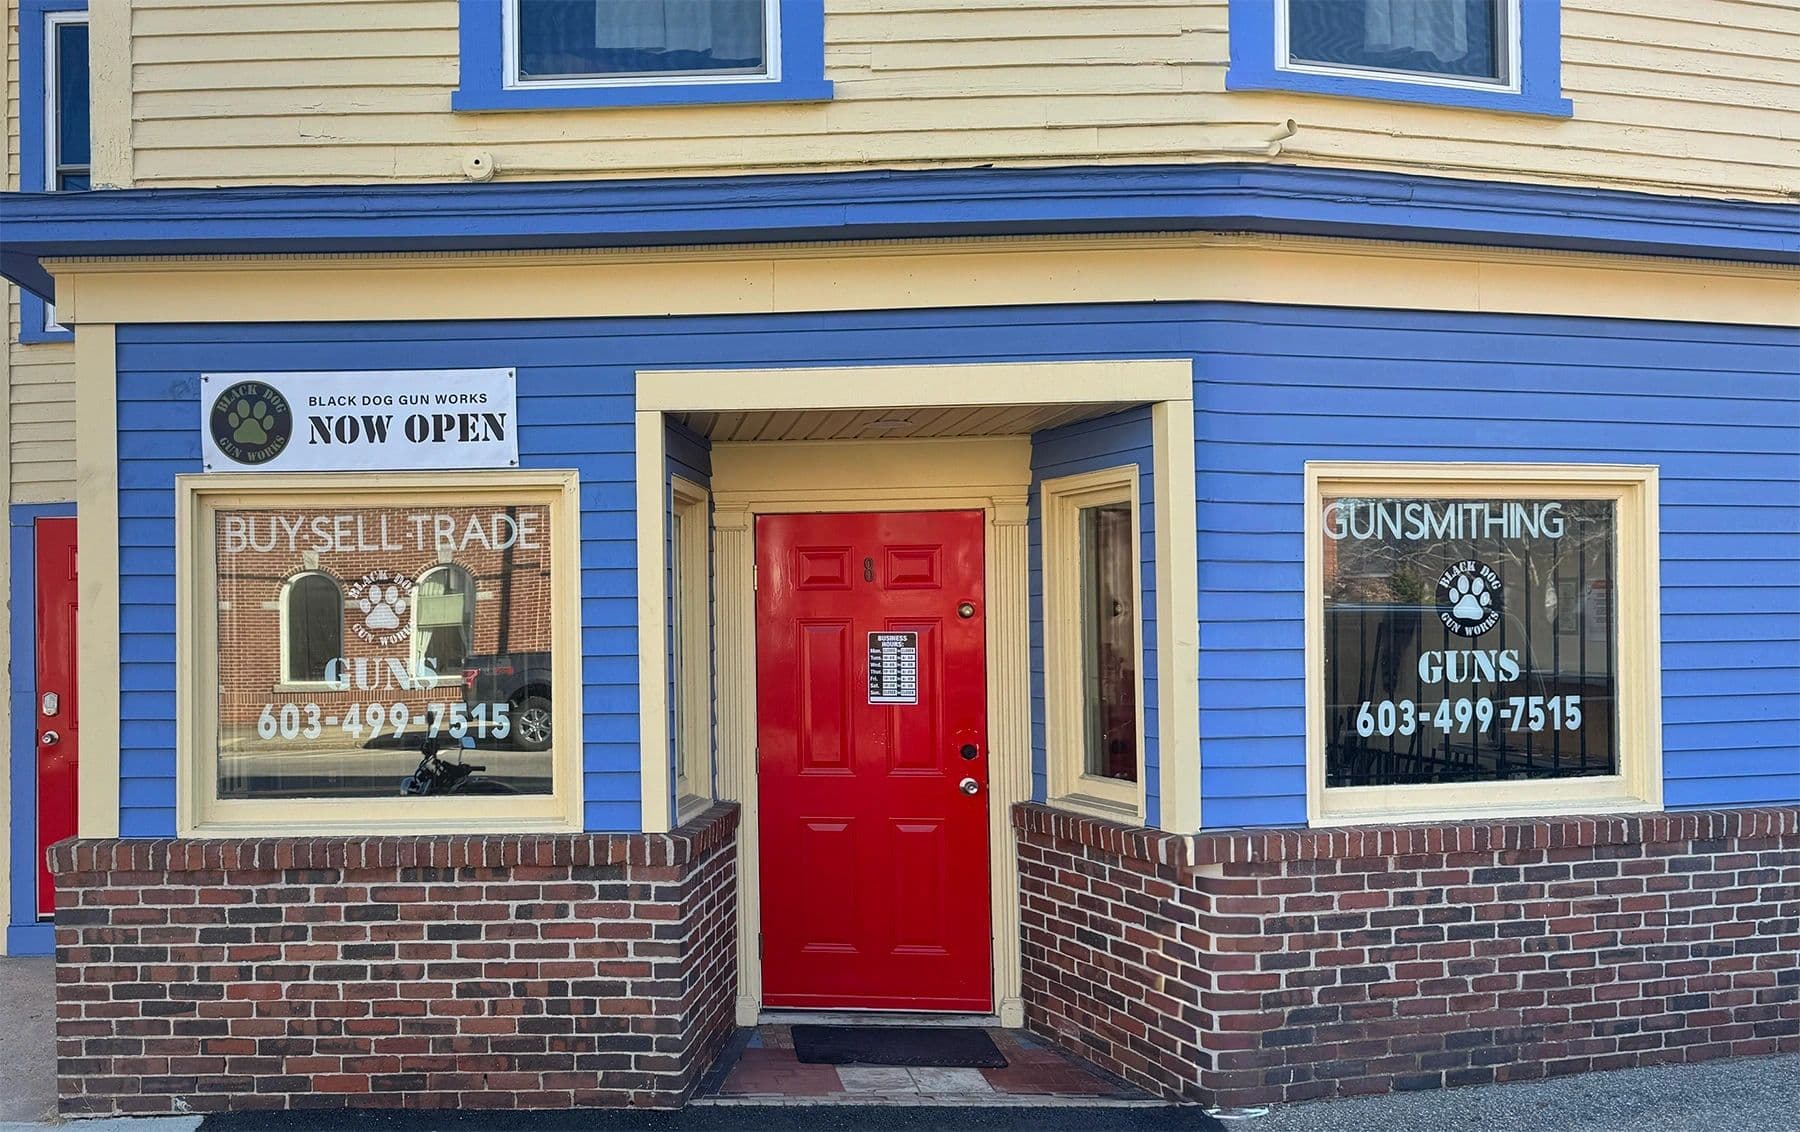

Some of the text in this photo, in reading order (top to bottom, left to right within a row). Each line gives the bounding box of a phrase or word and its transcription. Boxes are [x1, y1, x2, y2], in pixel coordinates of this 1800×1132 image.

[217, 384, 287, 413] BLACK DOG
[308, 393, 488, 407] BLACK DOG GUN WORKS
[308, 412, 507, 445] NOW OPEN
[219, 434, 286, 461] GUN WORKS
[1322, 502, 1565, 541] GUNSMITHING
[348, 570, 388, 599] BLACK
[863, 557, 874, 583] 8
[1439, 560, 1502, 590] BLACK DOG
[352, 623, 375, 643] GUN
[1441, 610, 1500, 636] GUN WORKS
[324, 656, 438, 690] GUNS
[1418, 649, 1520, 684] GUNS
[257, 702, 511, 740] 603-499-7515
[1356, 694, 1583, 738] 603-499-7515
